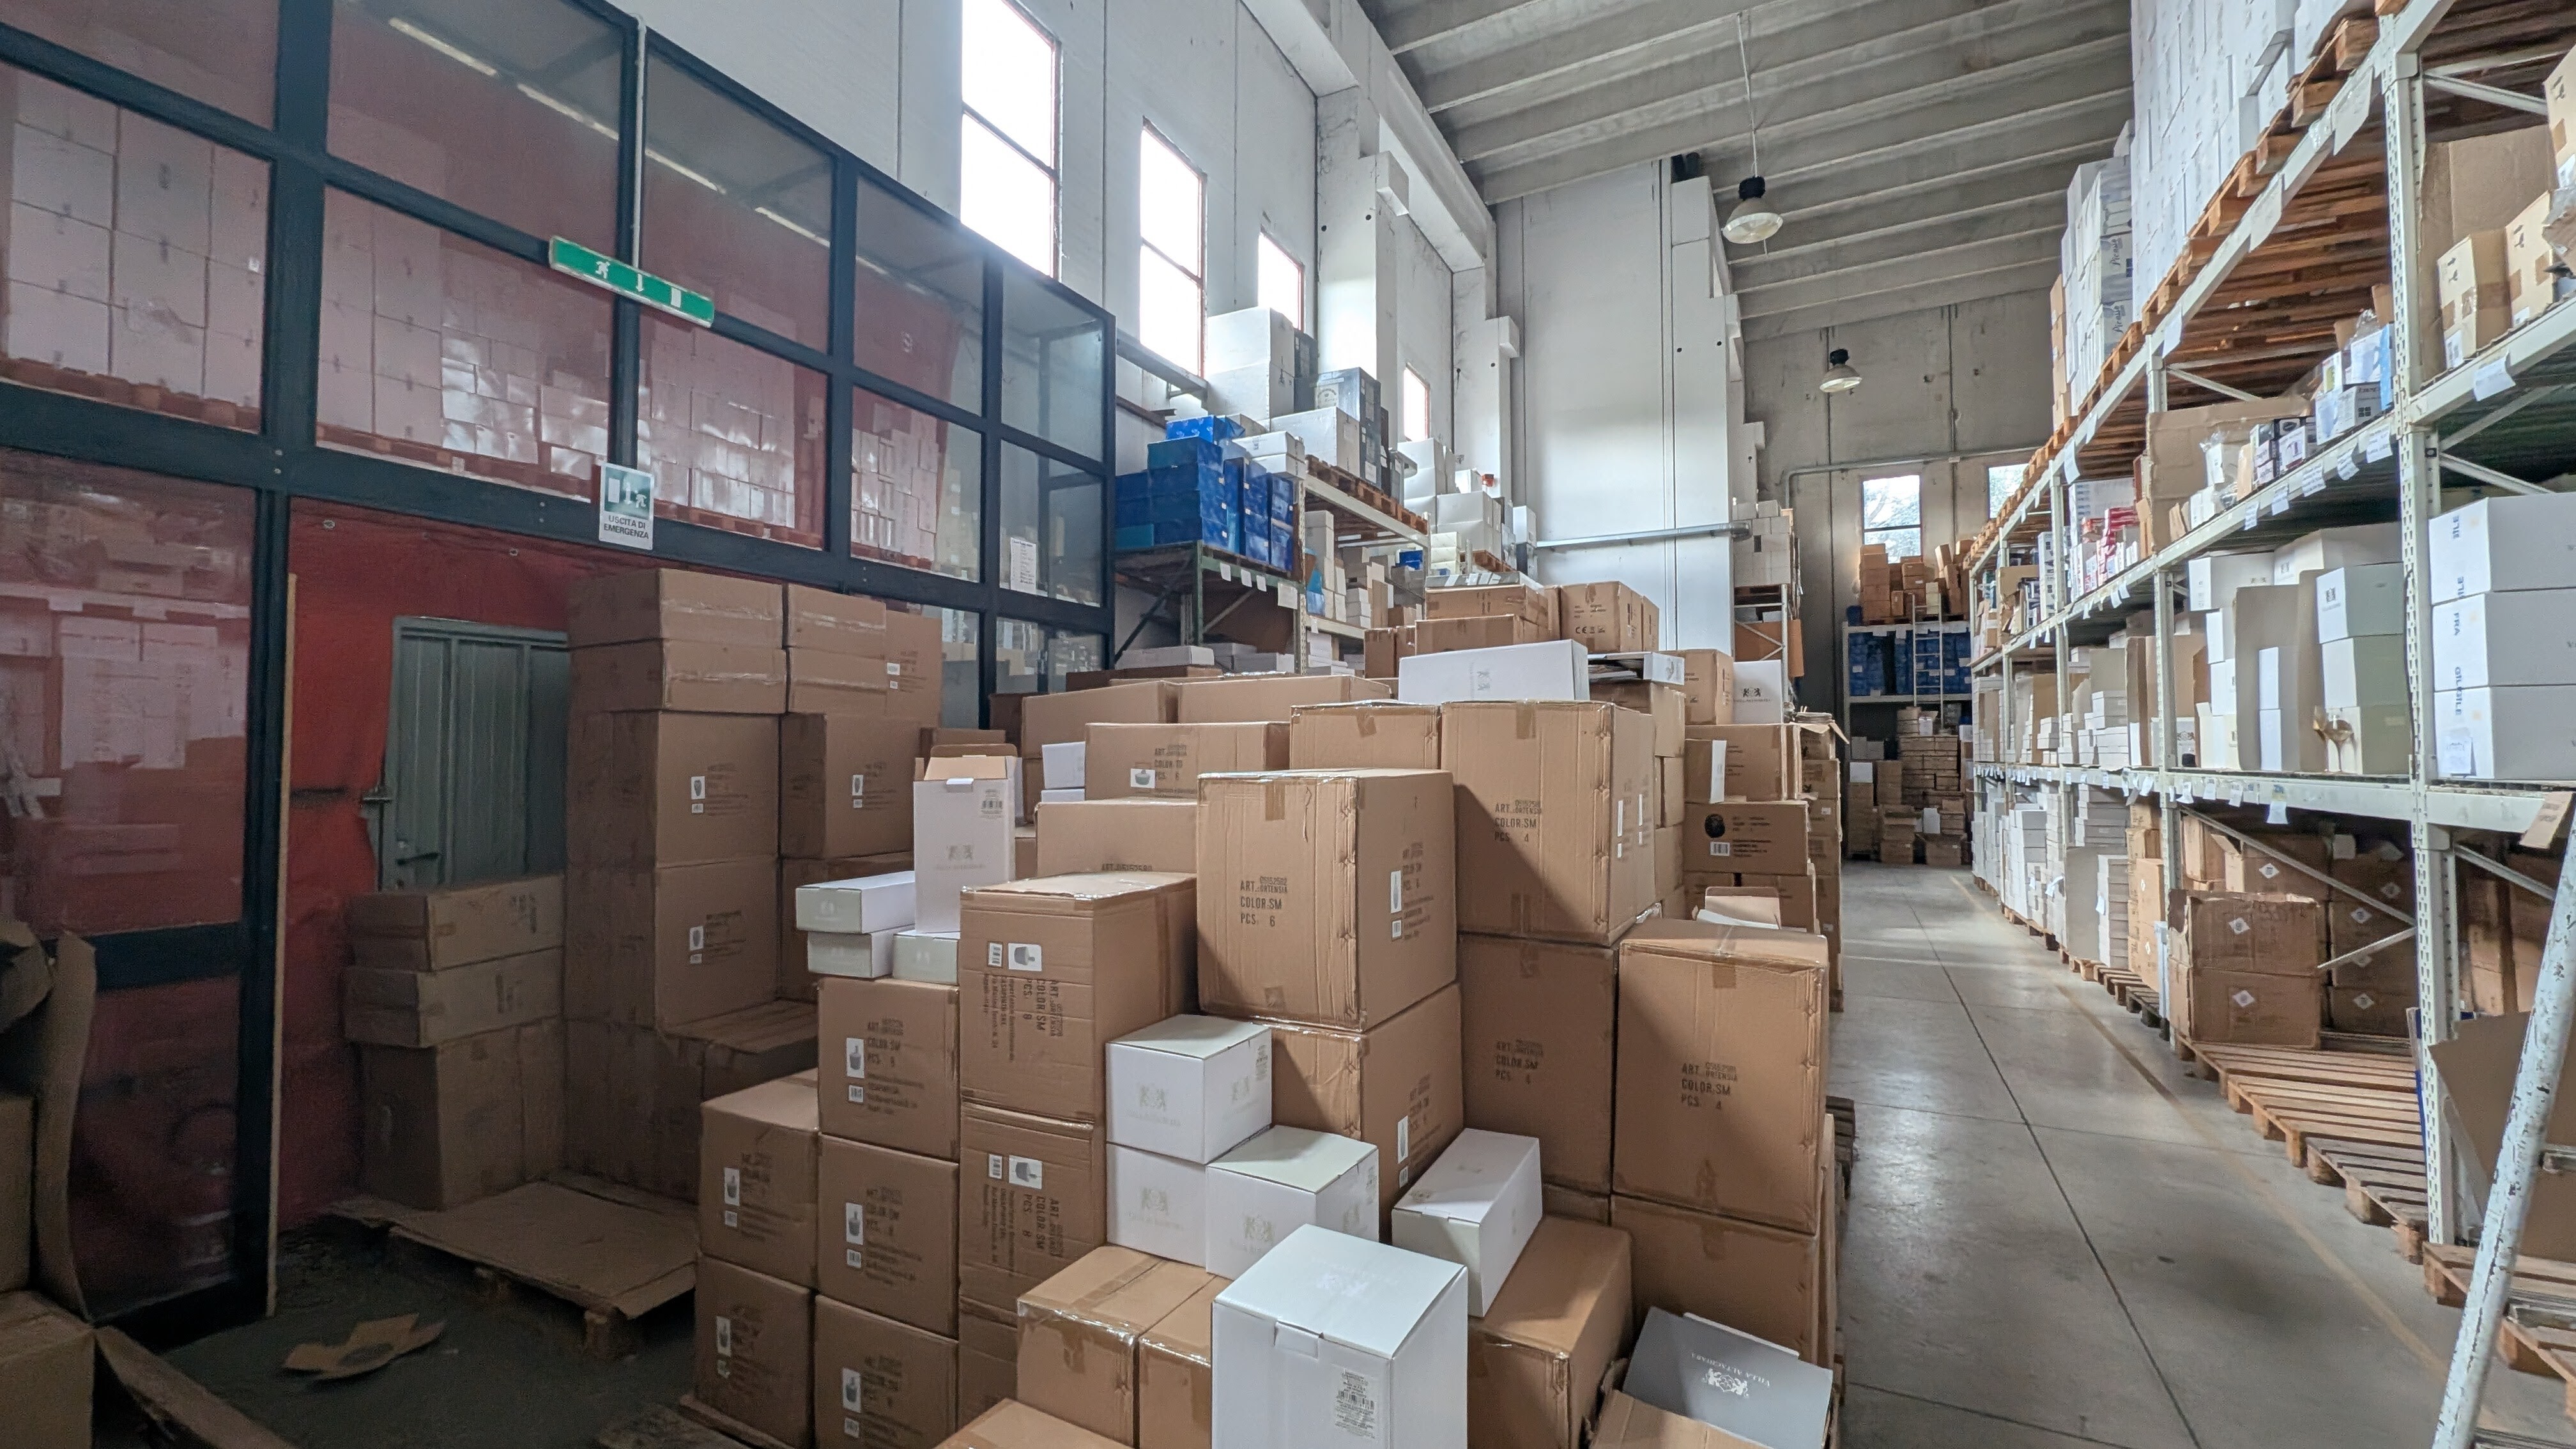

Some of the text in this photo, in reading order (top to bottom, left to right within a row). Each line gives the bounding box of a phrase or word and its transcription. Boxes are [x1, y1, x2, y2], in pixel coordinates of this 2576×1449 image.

[608, 515, 646, 530] USCITA DI
[604, 523, 649, 539] EMERGENZA
[1269, 915, 1275, 927] 6
